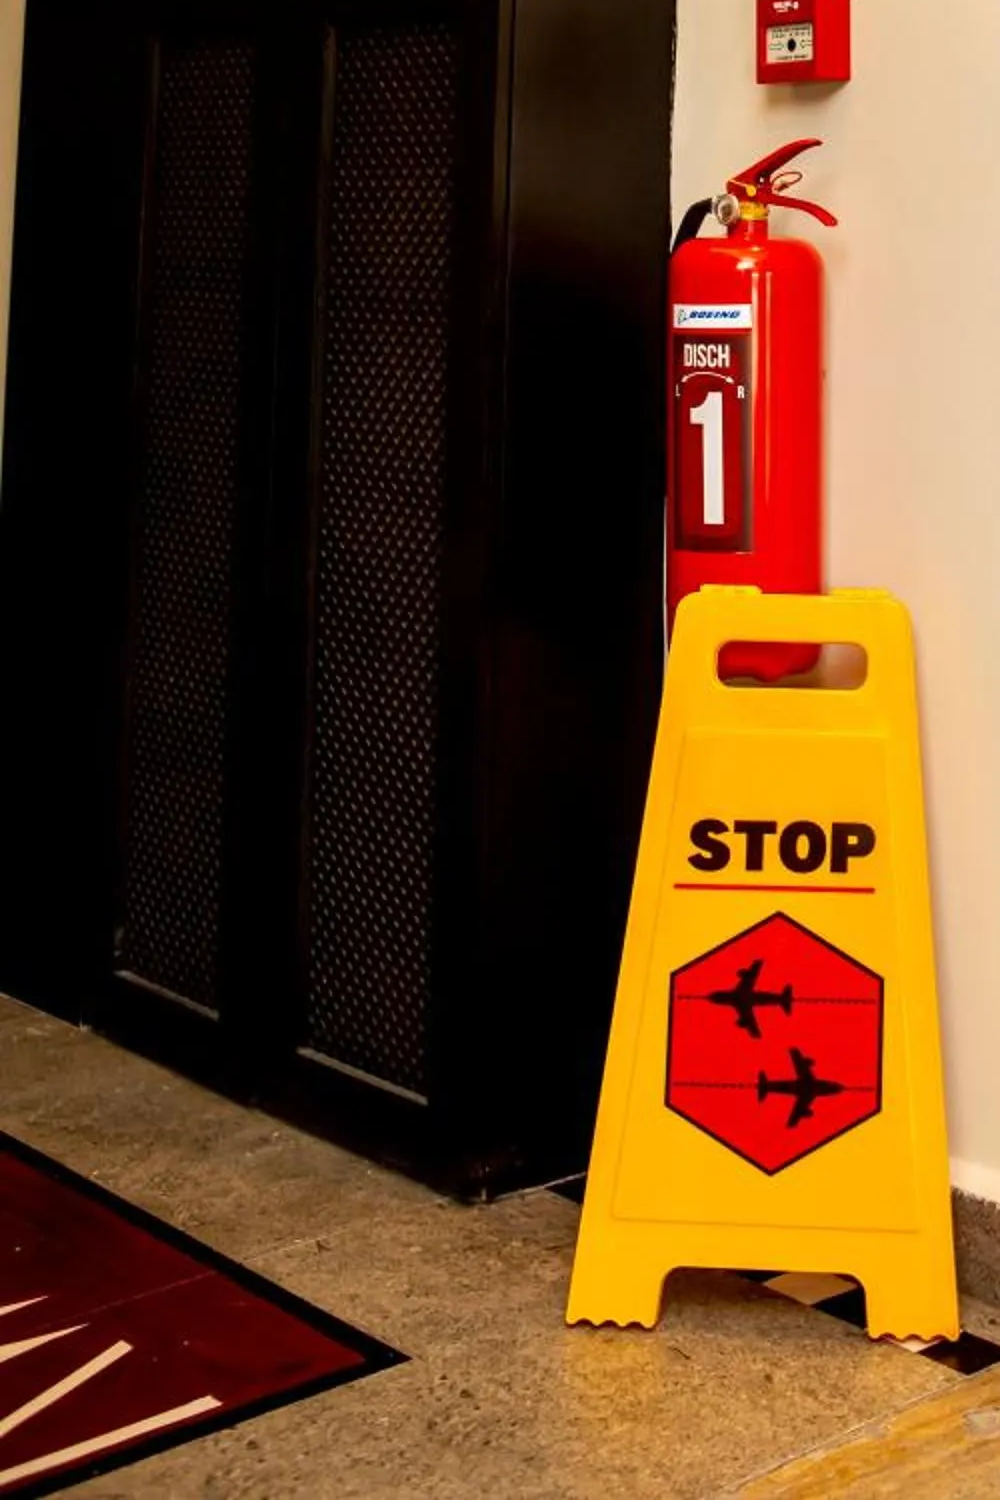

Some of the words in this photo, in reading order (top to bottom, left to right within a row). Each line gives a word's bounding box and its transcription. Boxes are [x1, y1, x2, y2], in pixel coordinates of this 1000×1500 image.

[689, 310, 741, 319] BOEING
[683, 343, 730, 368] DISCH
[675, 384, 681, 397] L
[737, 385, 745, 399] R
[690, 391, 725, 525] 1
[687, 818, 877, 874] STOP
